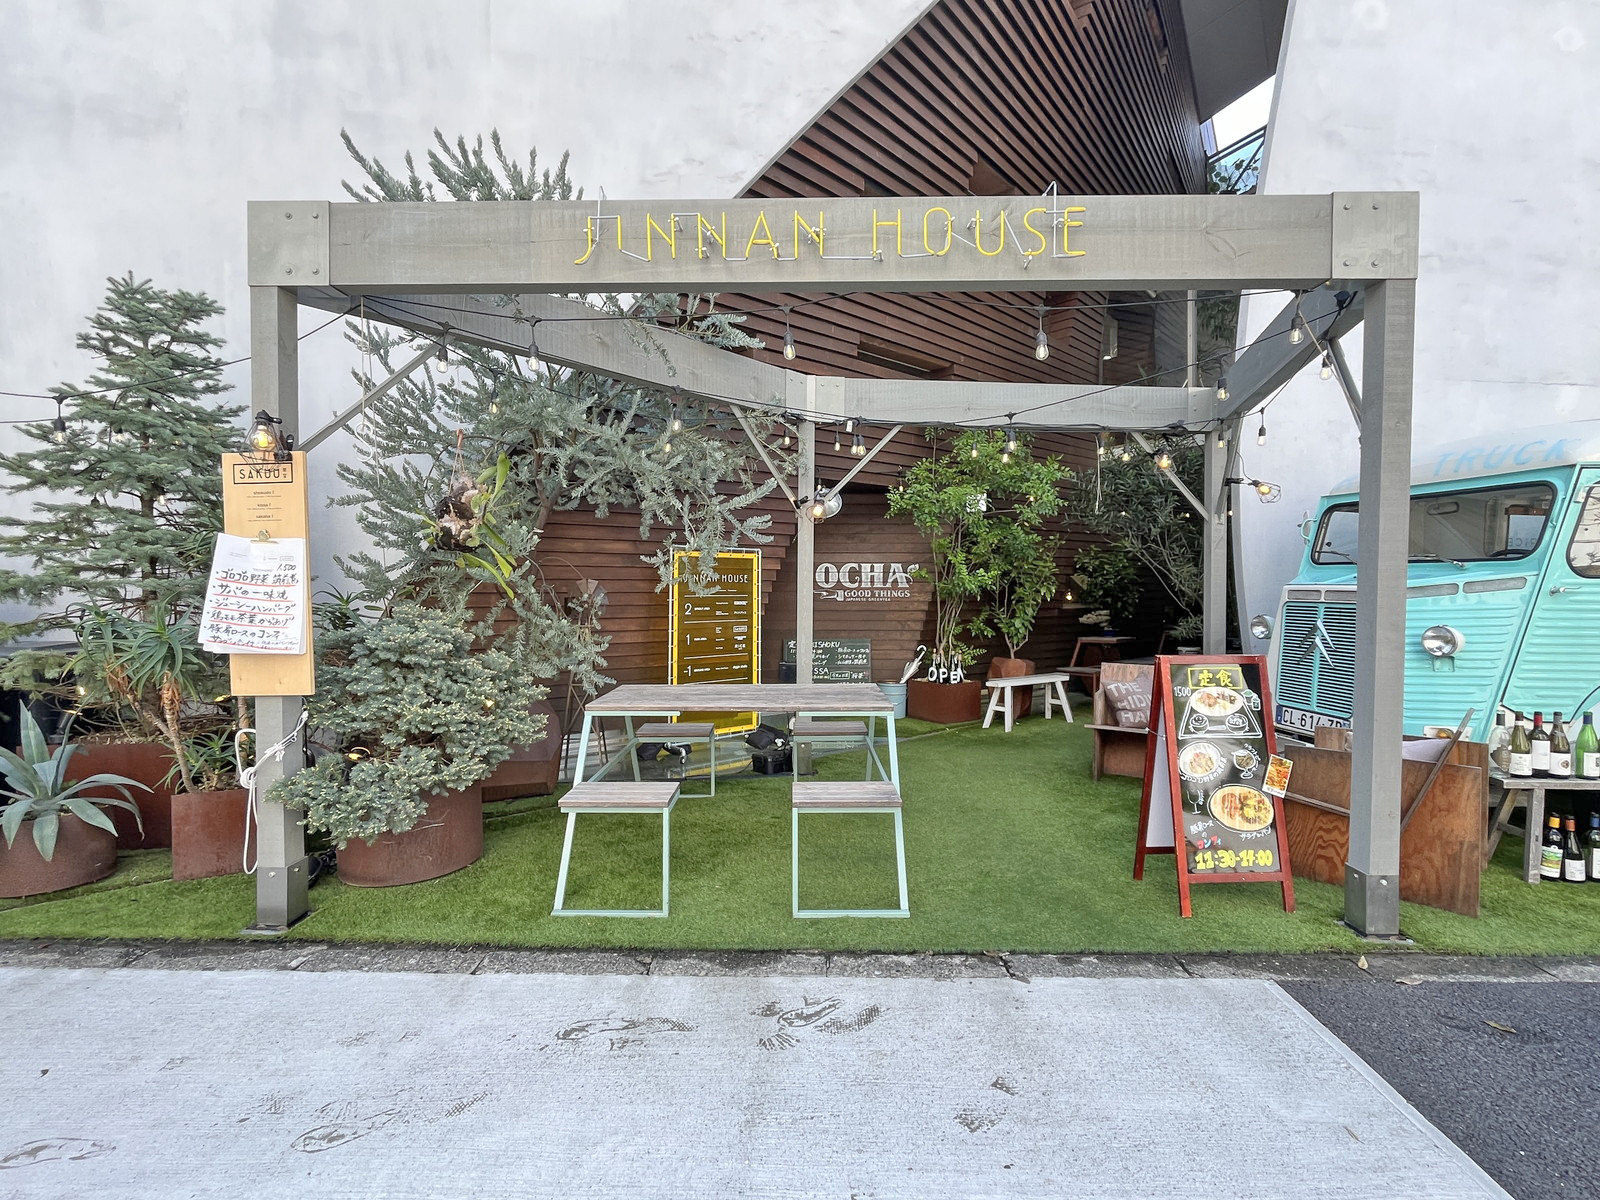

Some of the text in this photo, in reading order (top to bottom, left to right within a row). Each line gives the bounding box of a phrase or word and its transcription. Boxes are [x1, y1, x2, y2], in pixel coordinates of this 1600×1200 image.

[574, 206, 1087, 265] JINNAN HOUSE
[1433, 438, 1579, 476] TRUCK
[721, 574, 749, 583] HOUSE
[815, 562, 914, 589] OCHA
[844, 589, 911, 598] GOOD THINGS
[684, 602, 692, 615] 2
[685, 633, 690, 646] 1
[683, 665, 692, 677] -1
[1198, 669, 1233, 687] 定食
[1107, 682, 1142, 697] THE
[1174, 686, 1192, 697] 1500
[1120, 710, 1149, 723] HA
